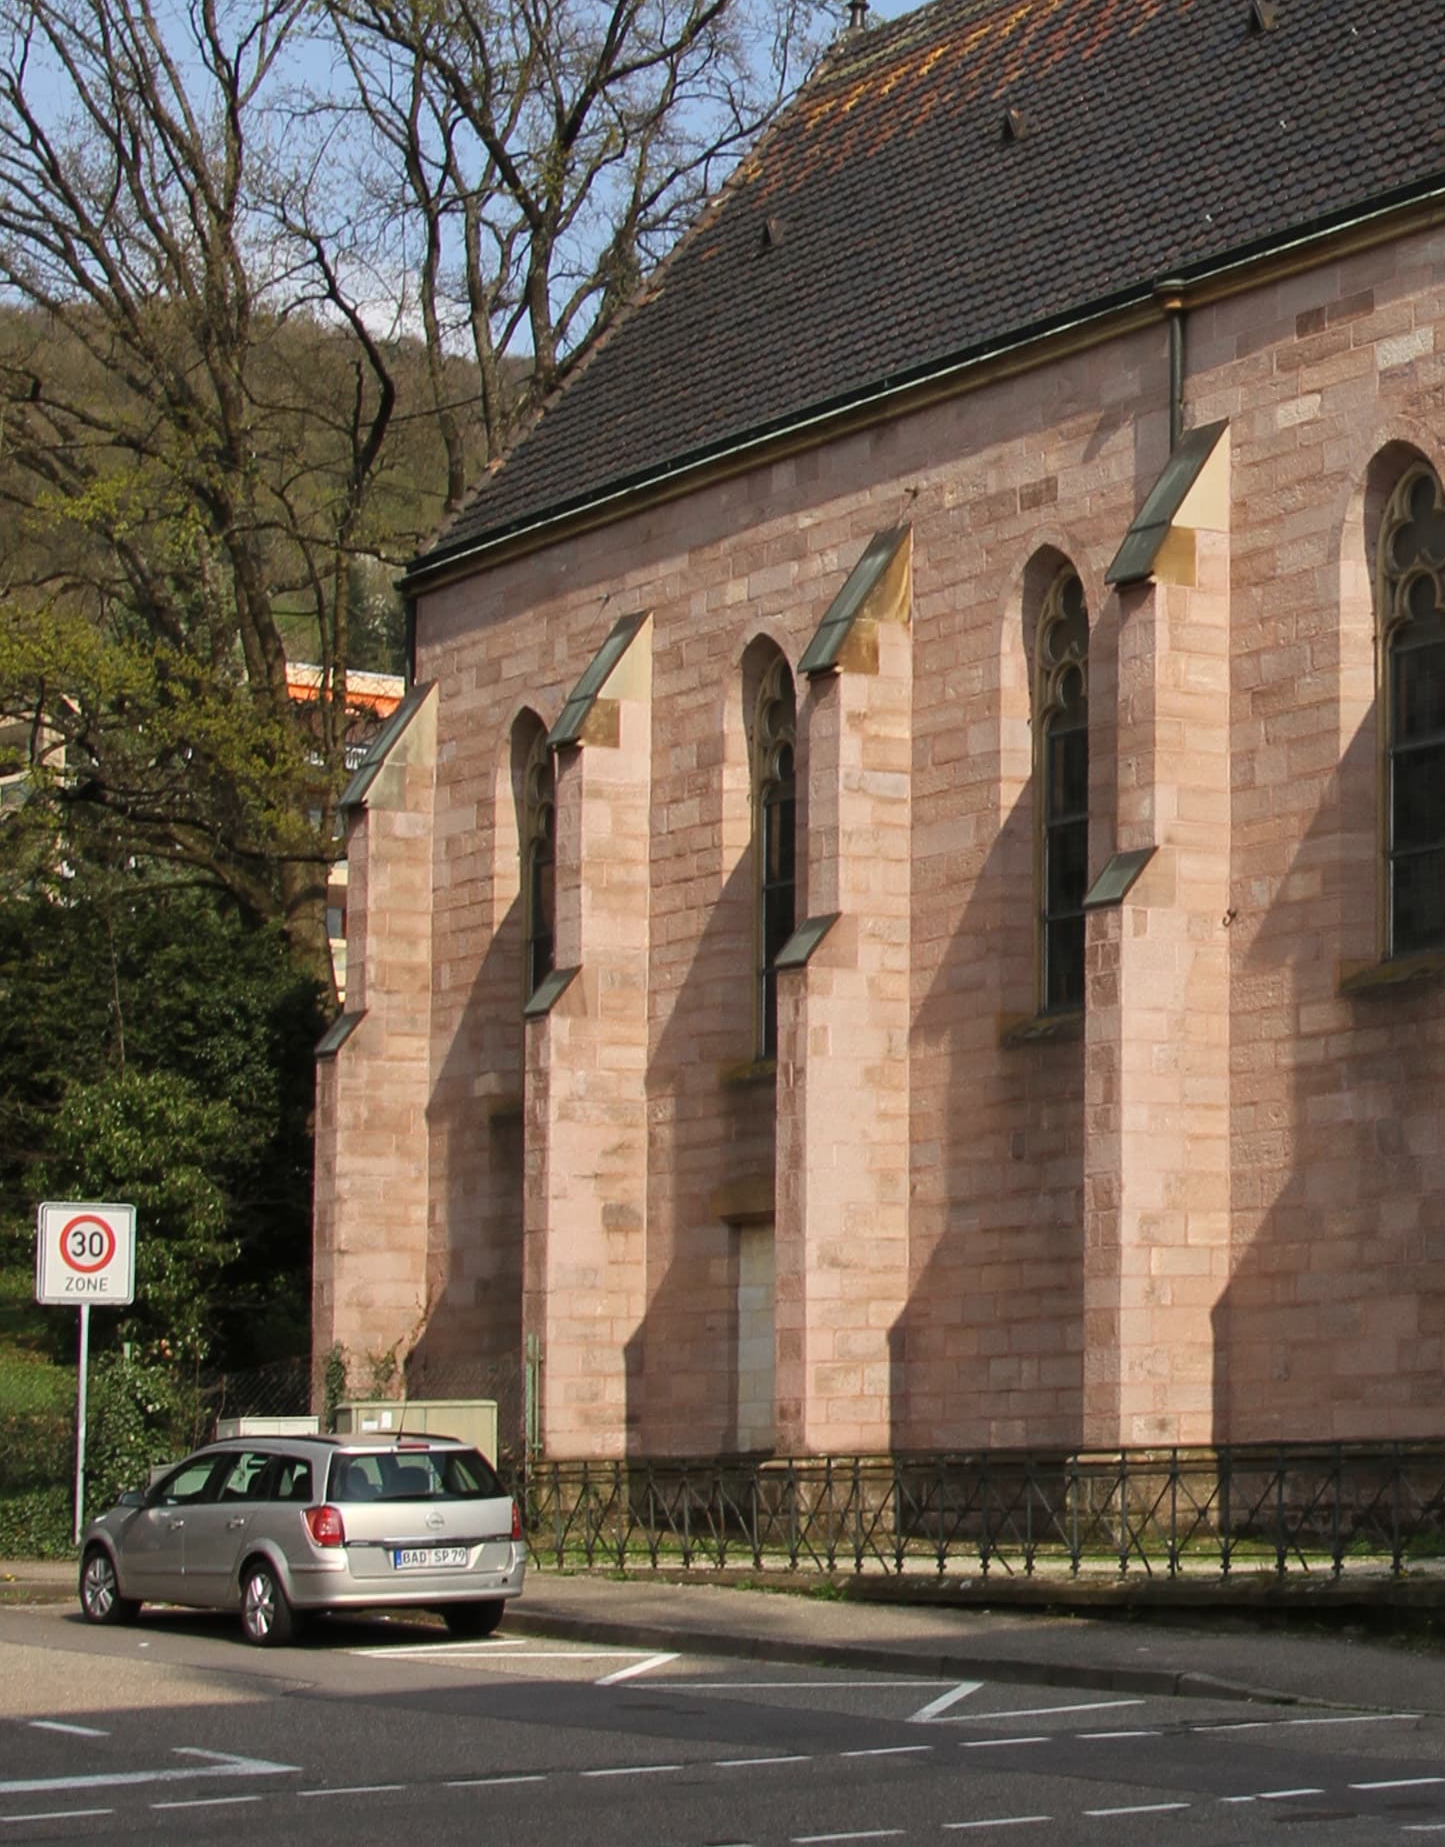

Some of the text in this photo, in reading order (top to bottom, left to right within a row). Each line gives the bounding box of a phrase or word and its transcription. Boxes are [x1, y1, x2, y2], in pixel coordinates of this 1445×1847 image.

[71, 1231, 103, 1257] 30
[65, 1277, 108, 1291] ZONE
[403, 1552, 427, 1564] BAD
[434, 1549, 449, 1562] SP
